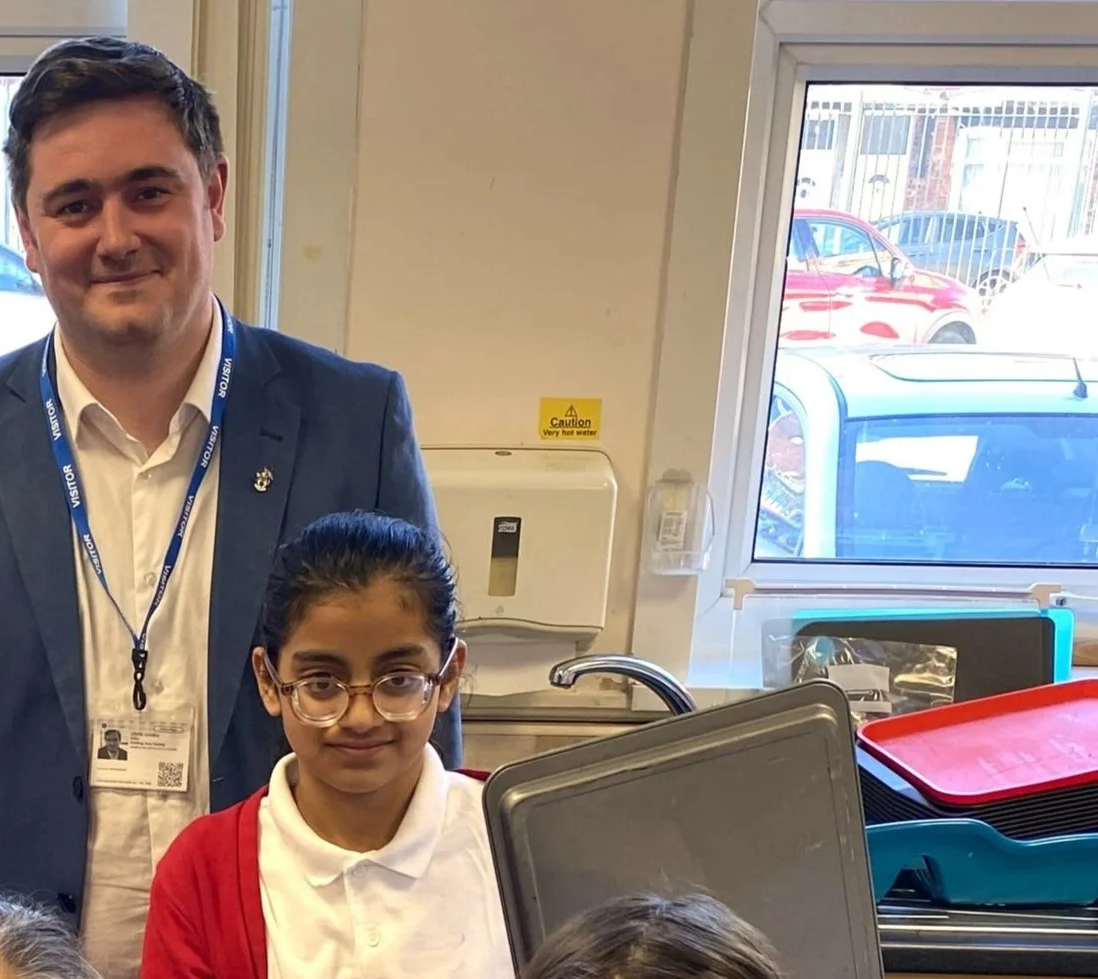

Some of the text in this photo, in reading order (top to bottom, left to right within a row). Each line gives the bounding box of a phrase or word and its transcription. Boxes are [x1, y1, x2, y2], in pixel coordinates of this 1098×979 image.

[218, 358, 233, 398] VISITOR
[46, 398, 61, 440] VISITOR
[542, 429, 560, 438] Very
[550, 416, 592, 428] Caution
[201, 425, 219, 468] VISITOR
[63, 464, 81, 508] VISITOR
[177, 495, 195, 537] VISITOR
[83, 533, 102, 575] VISITOR
